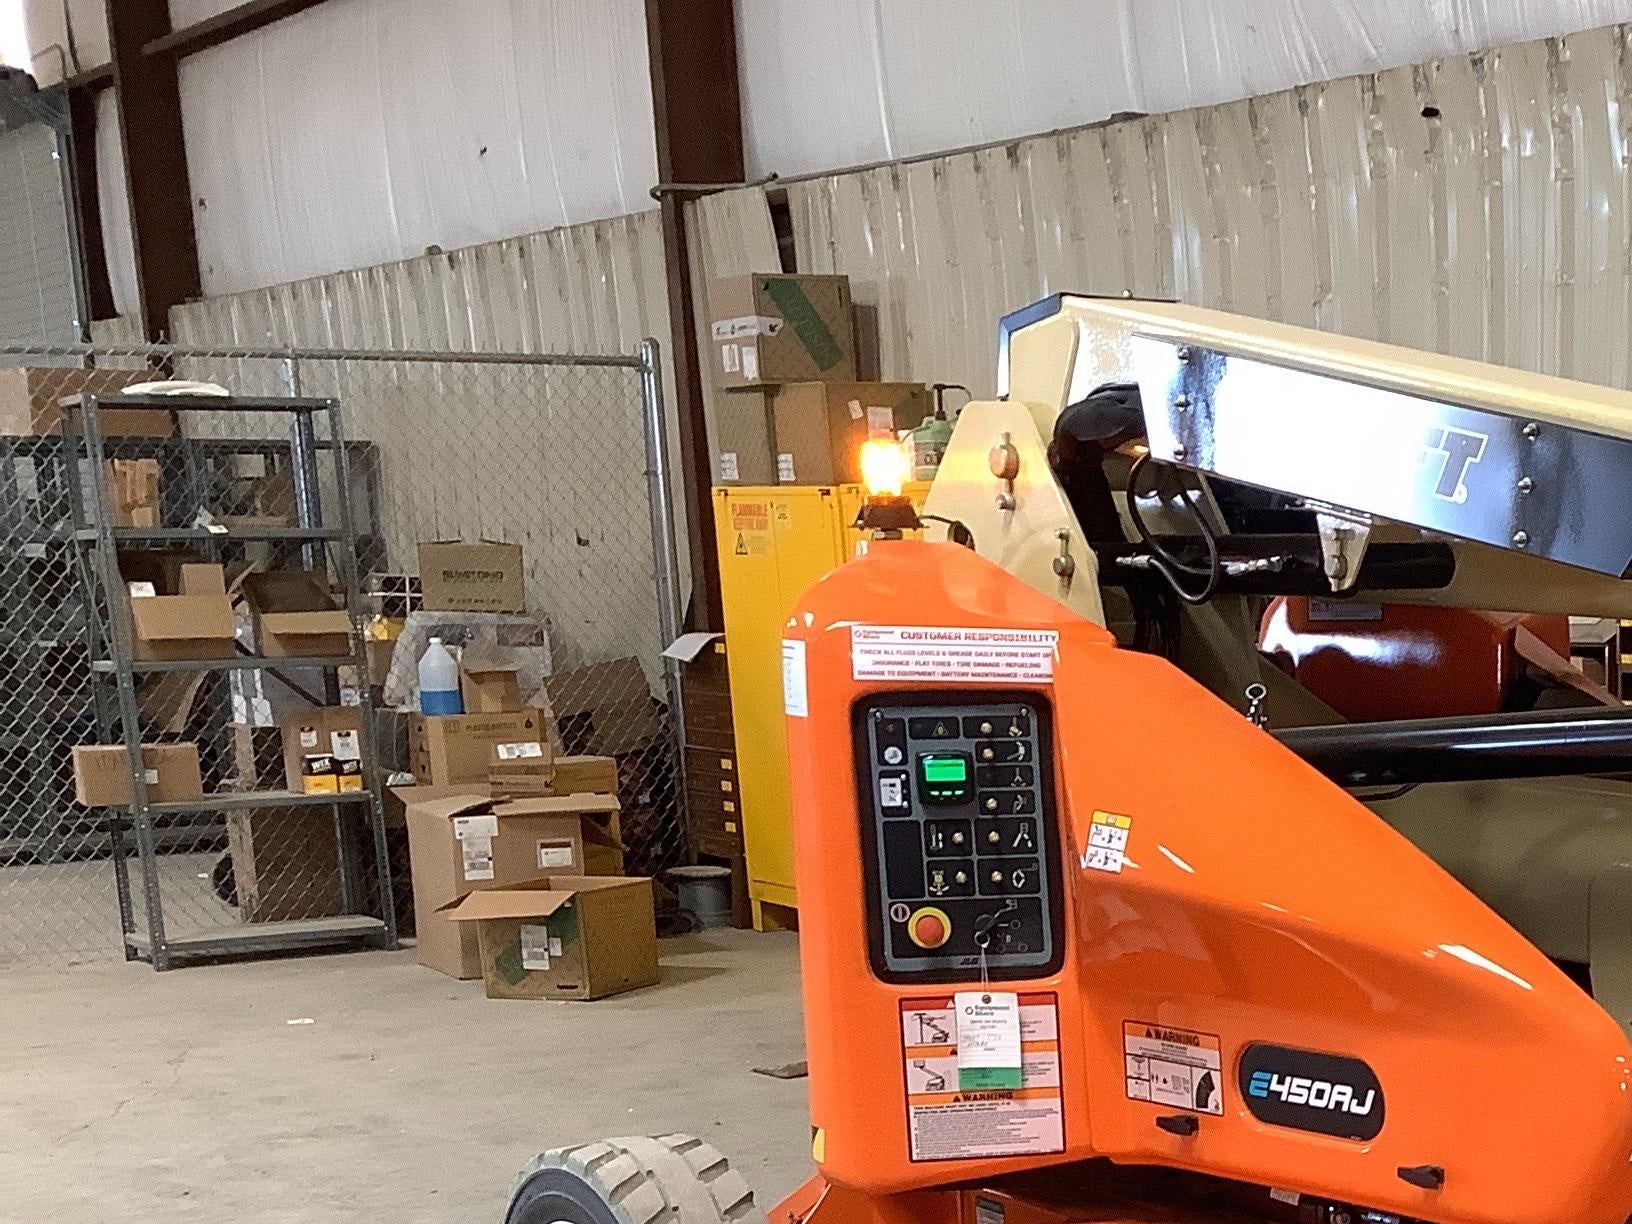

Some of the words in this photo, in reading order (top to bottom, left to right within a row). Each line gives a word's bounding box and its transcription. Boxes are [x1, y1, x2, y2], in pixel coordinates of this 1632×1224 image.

[900, 631, 962, 641] CUSTOMER
[964, 632, 1056, 642] RESPONSIBILITY
[1153, 1028, 1200, 1047] WARNING
[962, 1091, 1014, 1102] WARNING
[1249, 1071, 1375, 1116] E450AJ
